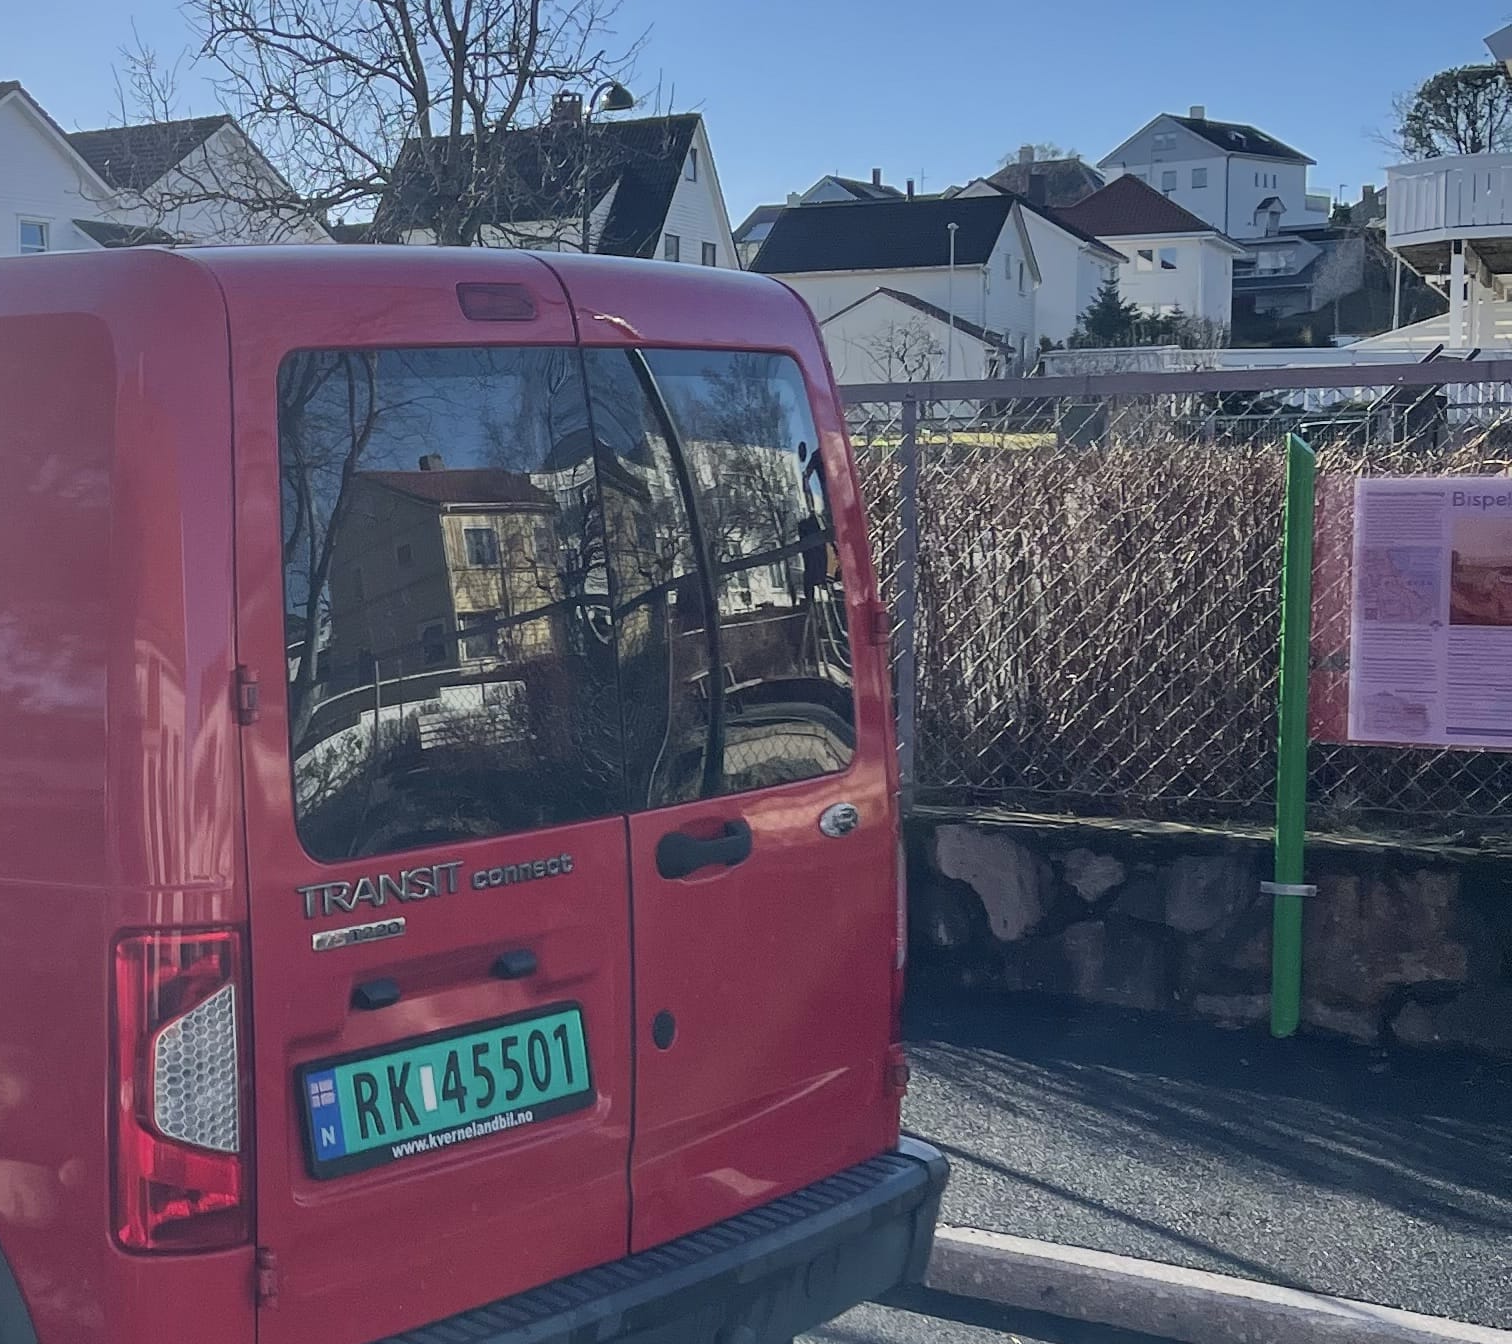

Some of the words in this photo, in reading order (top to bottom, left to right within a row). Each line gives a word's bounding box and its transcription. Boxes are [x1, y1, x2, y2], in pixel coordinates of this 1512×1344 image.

[297, 860, 464, 918] TRANSIT
[472, 853, 574, 890] connect
[352, 1061, 420, 1140] RK
[442, 1023, 573, 1113] 45501
[320, 1124, 336, 1147] N
[391, 1109, 534, 1159] www.kvernelandbil.no
